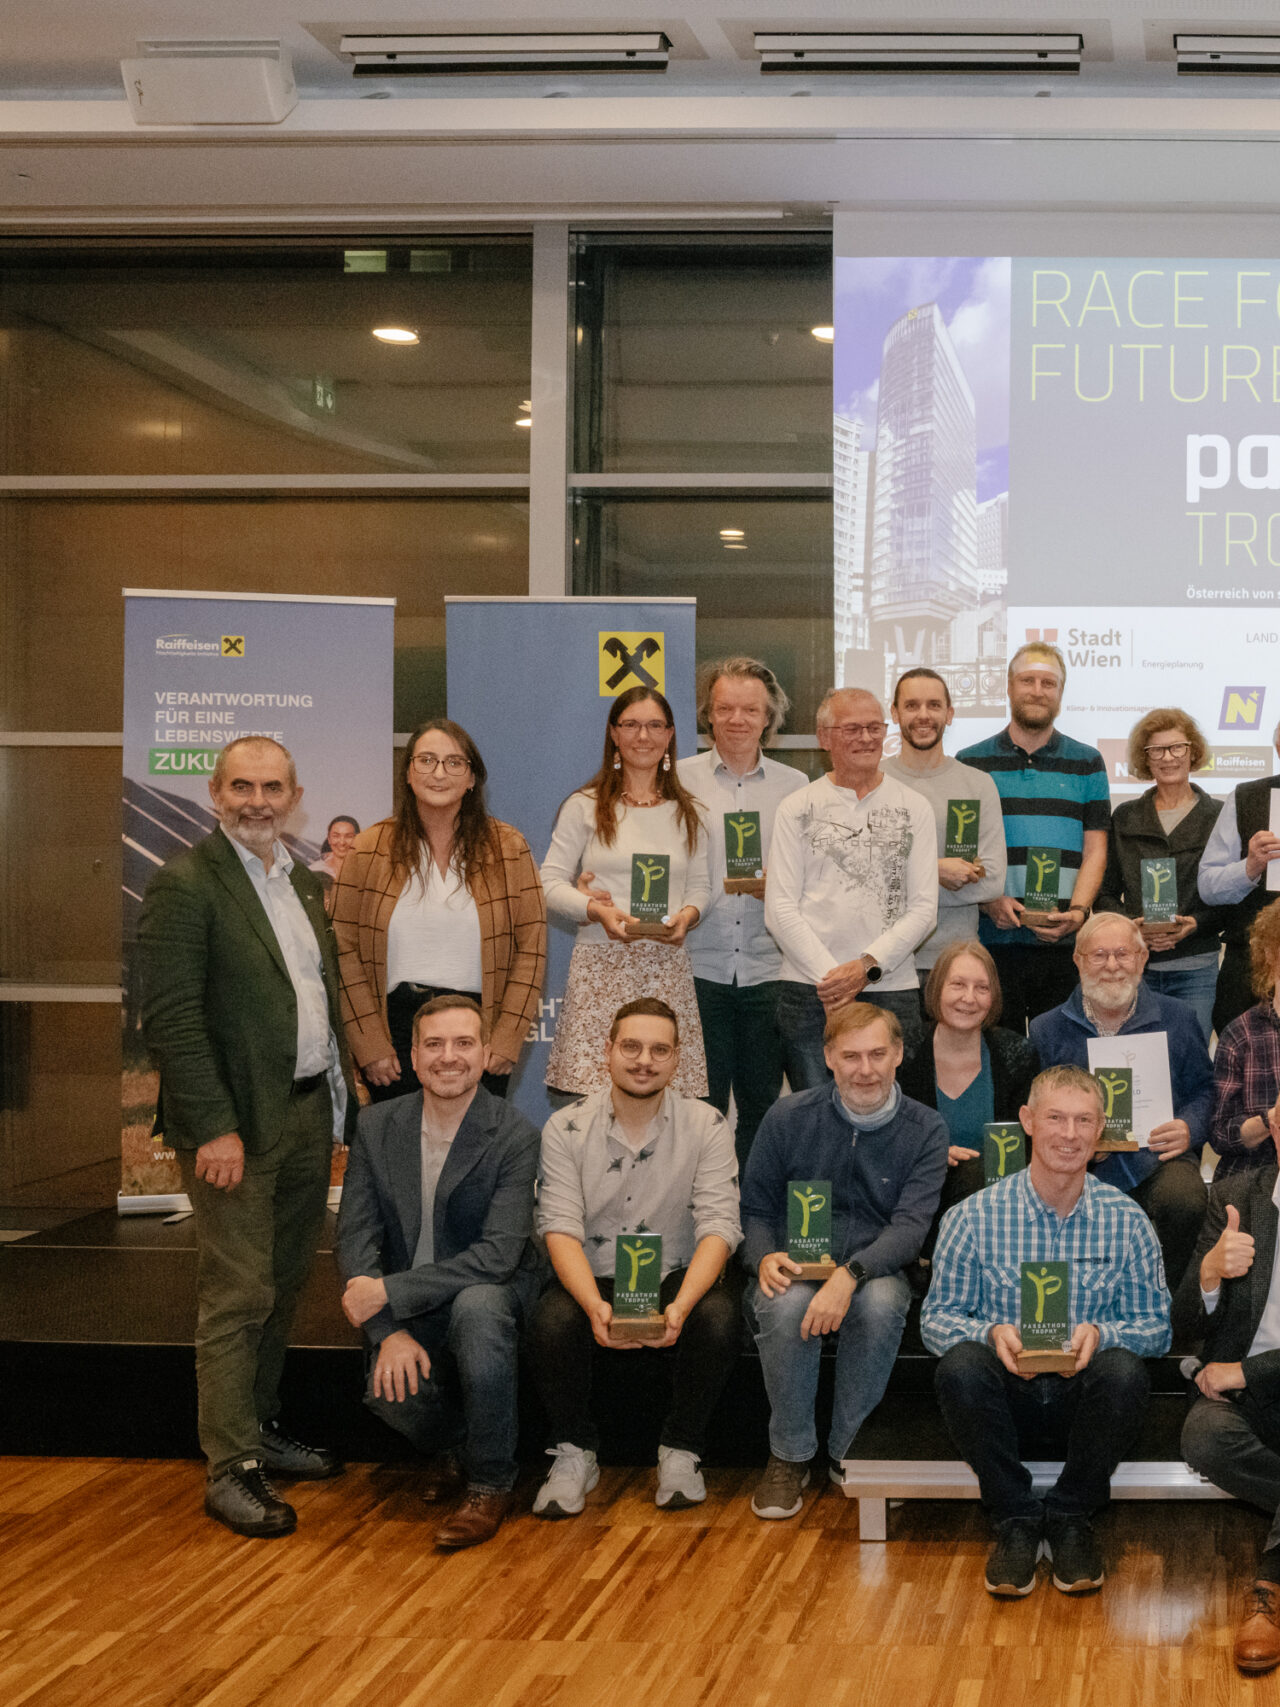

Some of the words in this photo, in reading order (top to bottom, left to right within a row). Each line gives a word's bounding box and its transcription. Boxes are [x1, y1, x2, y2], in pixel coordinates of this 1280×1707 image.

[1032, 270, 1208, 328] RACE
[1186, 584, 1250, 601] Österreich
[1252, 589, 1275, 601] von
[156, 638, 219, 651] Raiffeisen
[1068, 628, 1122, 647] Stadt
[1246, 632, 1278, 644] LAND
[1068, 649, 1122, 669] Wien
[1142, 660, 1205, 671] Energieplanung
[154, 691, 313, 708] VERANTWORTUNG
[155, 707, 190, 725] FÜR
[195, 711, 236, 725] EINE
[154, 752, 219, 771] ZUKU
[1216, 756, 1265, 767] Raiffeisen
